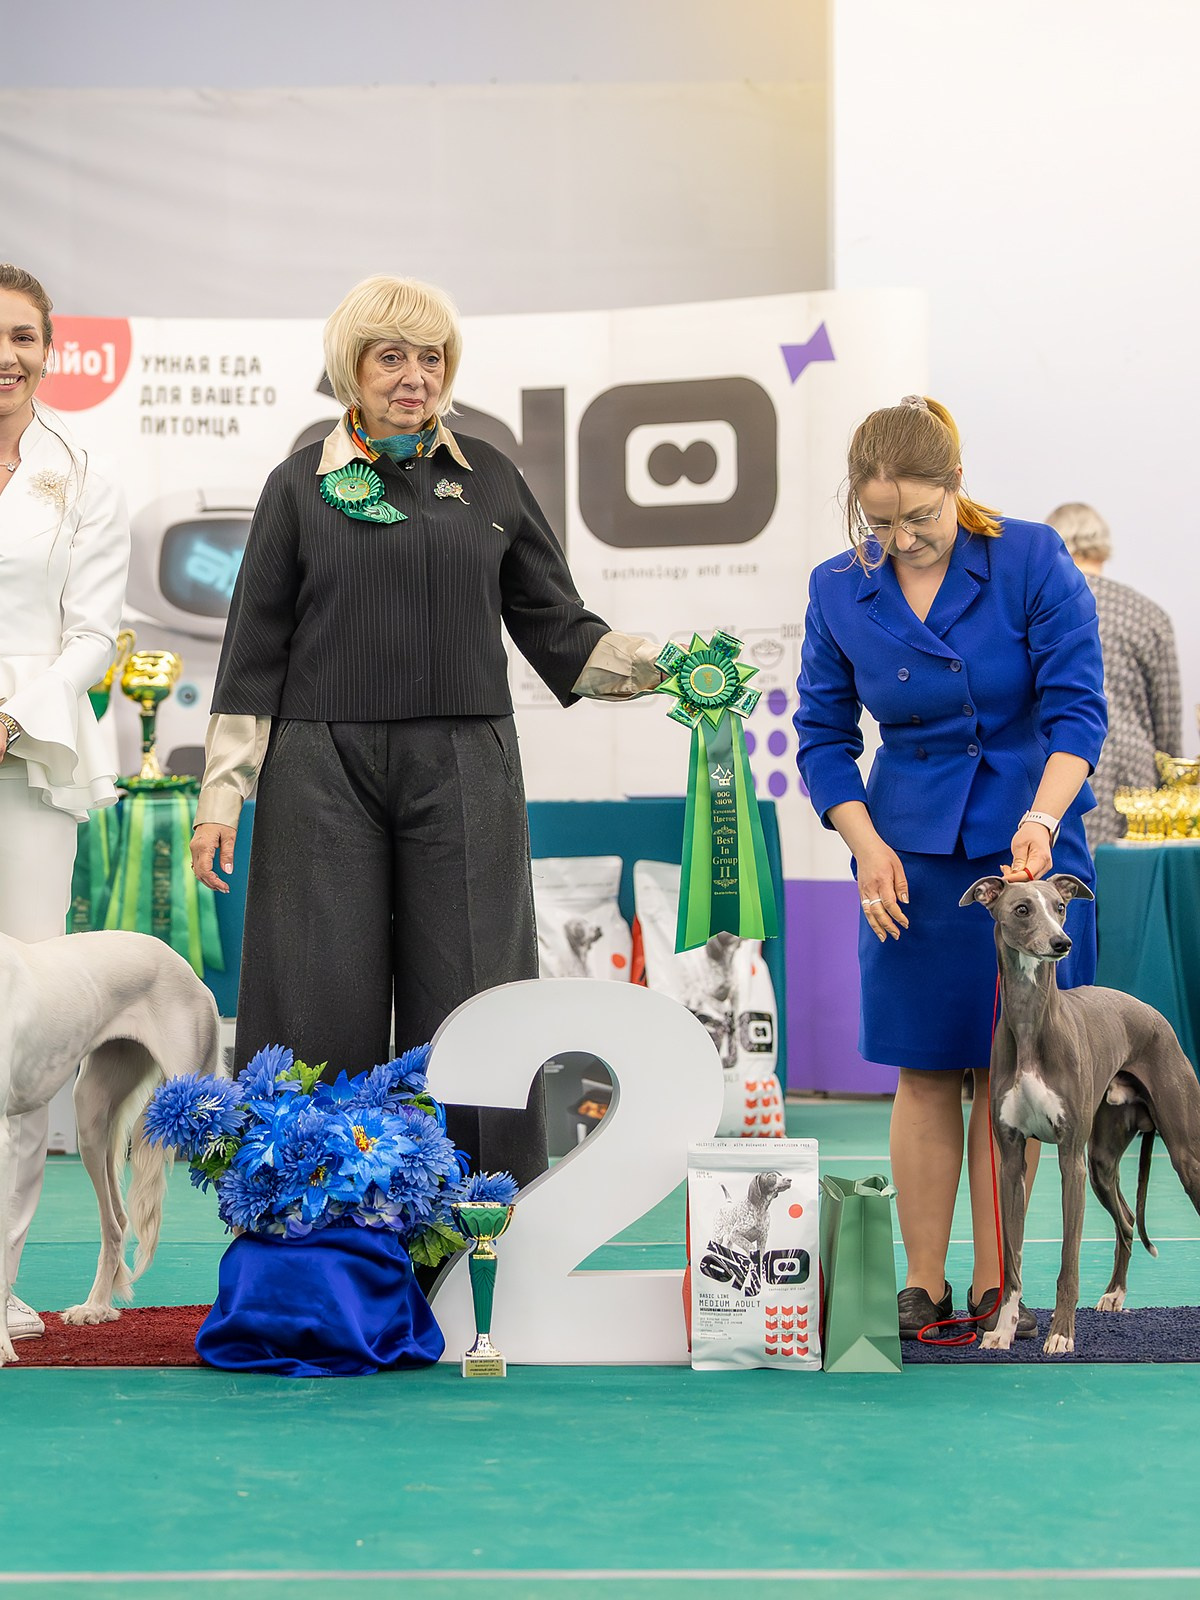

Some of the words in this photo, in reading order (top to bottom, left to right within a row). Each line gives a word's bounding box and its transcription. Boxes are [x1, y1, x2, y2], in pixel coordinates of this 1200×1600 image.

[141, 355, 211, 374] УМНАЯ
[220, 355, 262, 376] ЕДА
[140, 386, 182, 407] ДЛЯ
[191, 386, 277, 406] ВАШЕГО
[141, 416, 240, 438] ПИТОМЦА
[602, 566, 688, 580] technology
[697, 565, 721, 577] and
[716, 836, 734, 845] Best
[720, 846, 730, 854] In
[712, 856, 738, 866] Group
[720, 867, 730, 878] II
[424, 977, 725, 1364] 2
